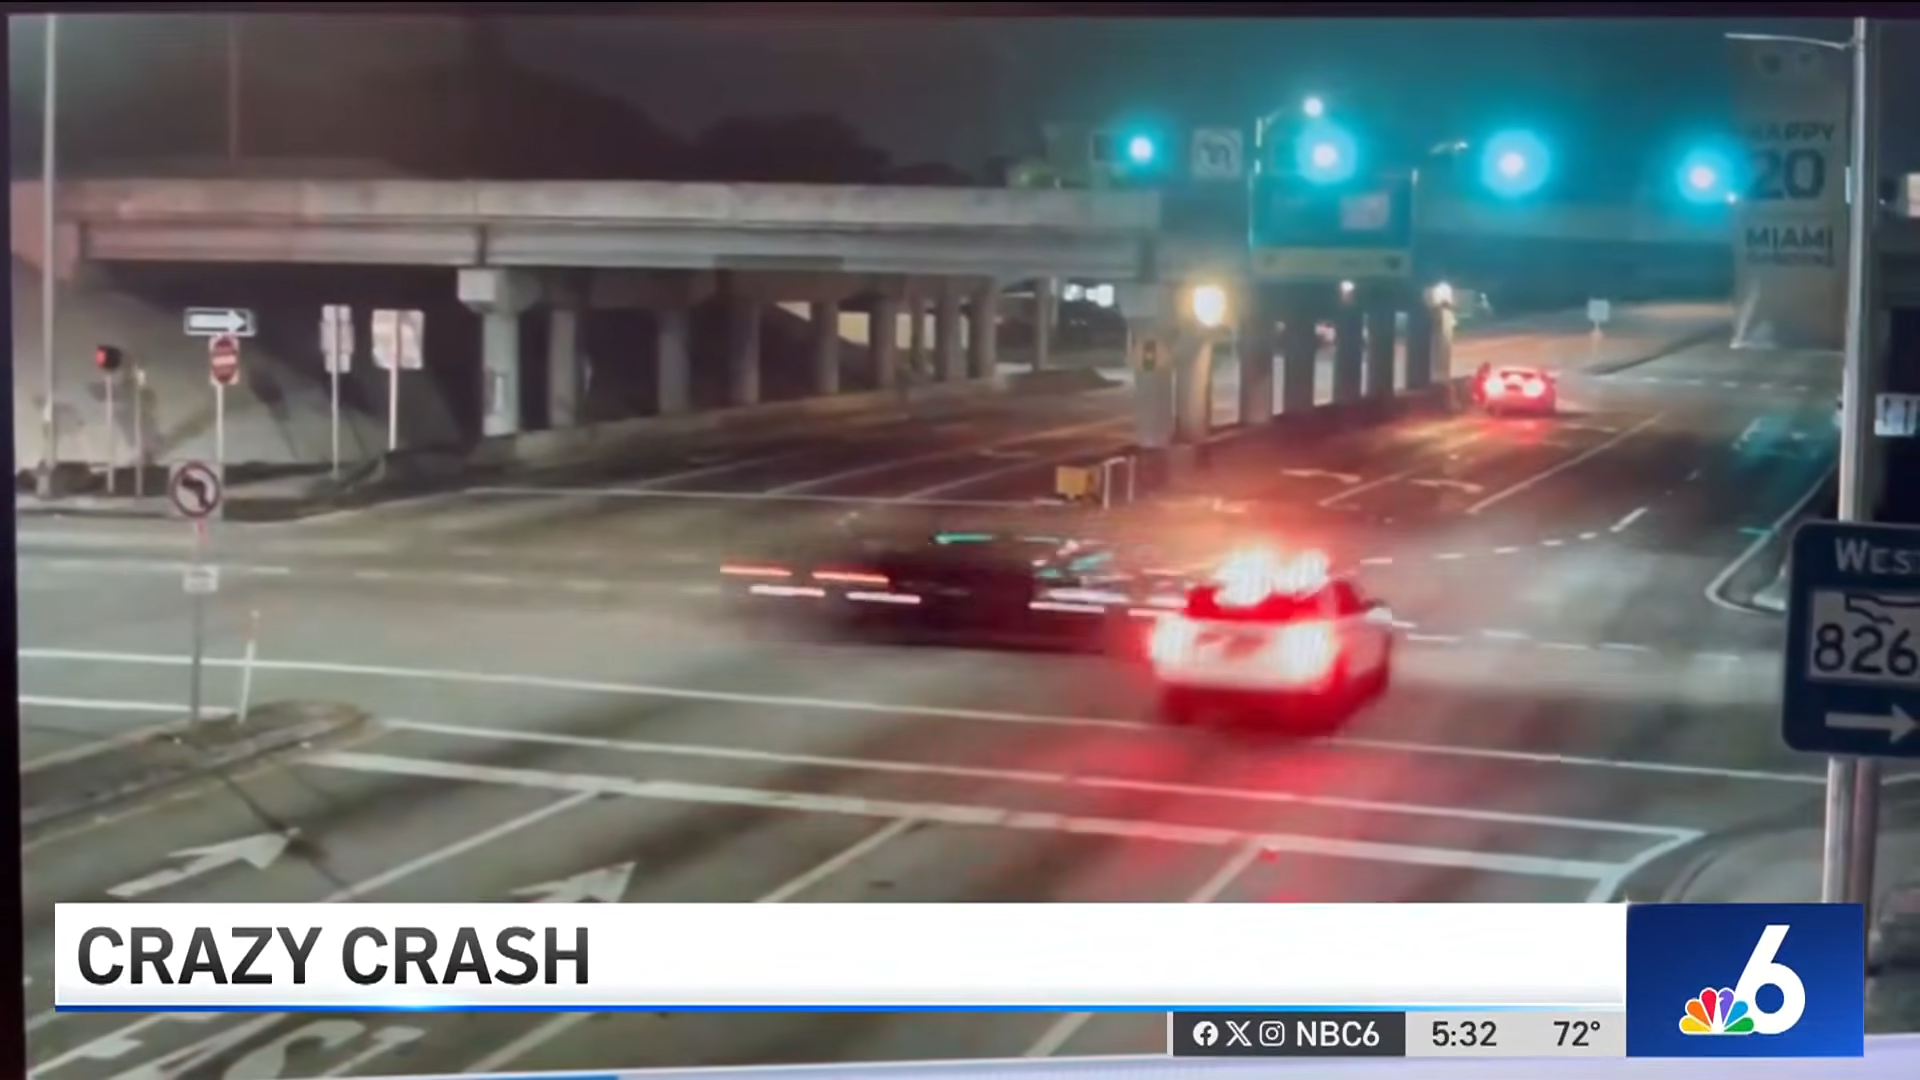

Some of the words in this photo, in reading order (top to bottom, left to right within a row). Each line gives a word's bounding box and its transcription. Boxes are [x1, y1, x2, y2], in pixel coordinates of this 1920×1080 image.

[1750, 148, 1825, 200] 20
[1746, 225, 1833, 248] MIAMI
[1814, 623, 1918, 676] 826
